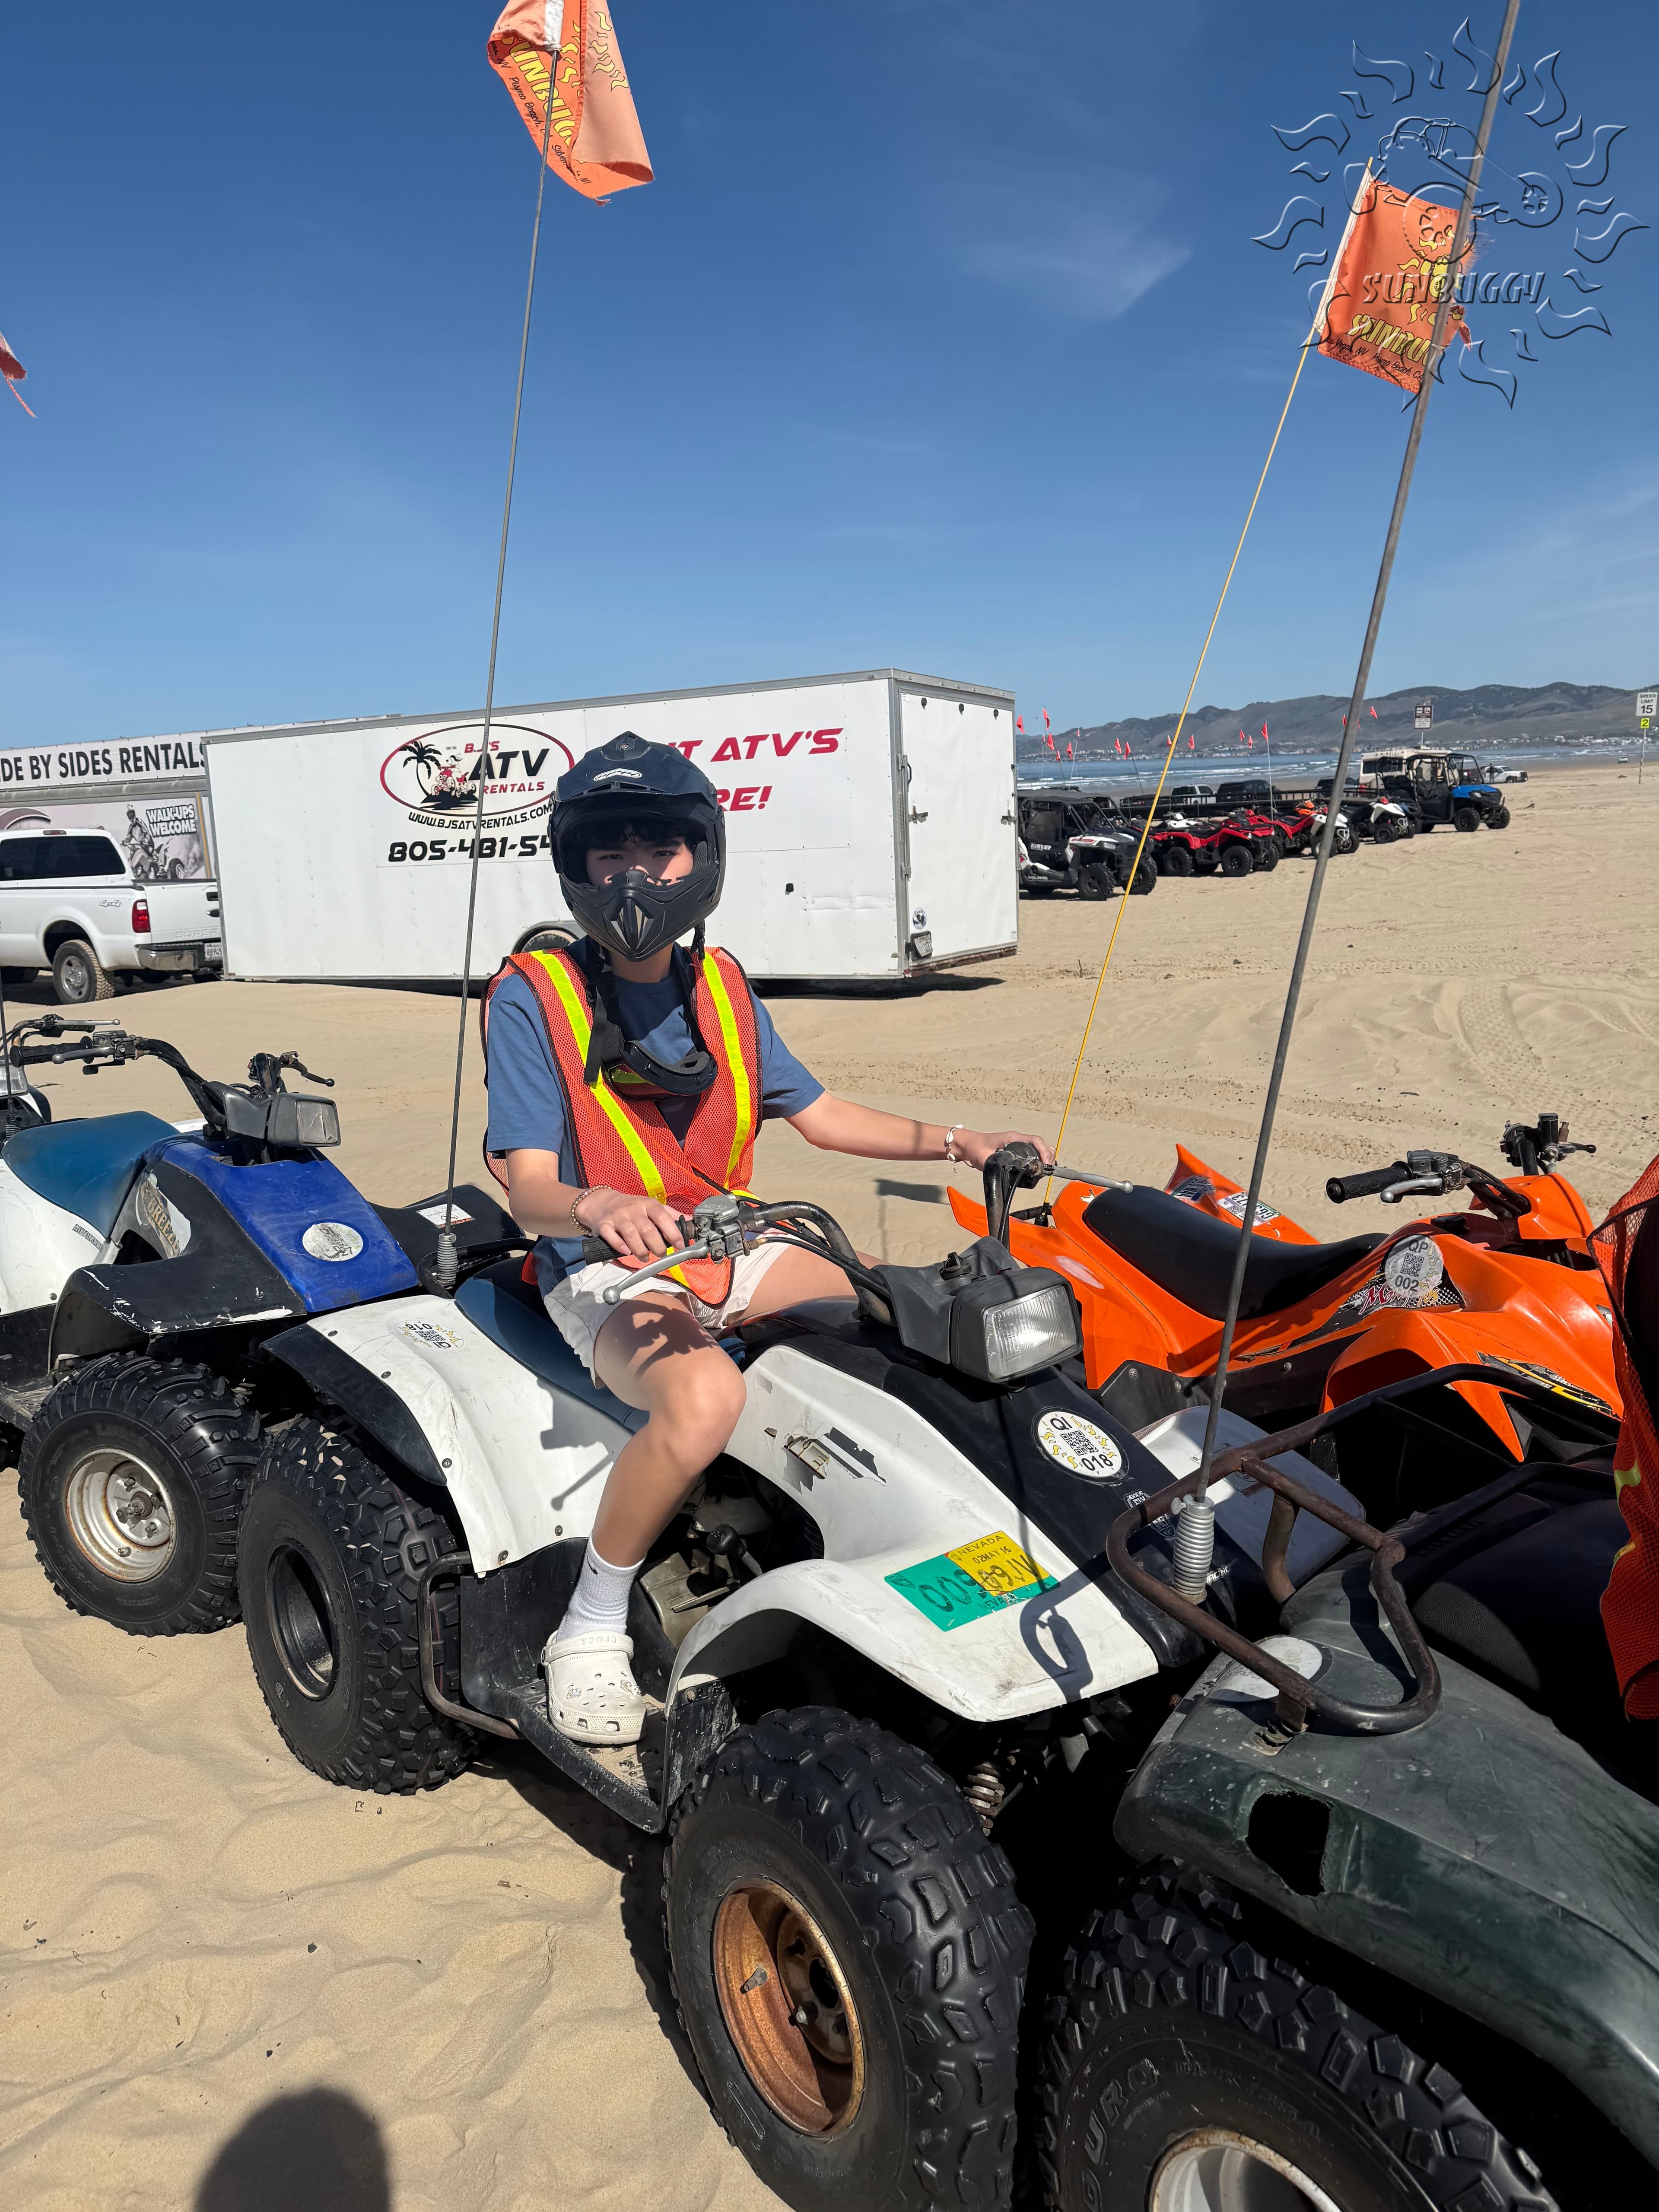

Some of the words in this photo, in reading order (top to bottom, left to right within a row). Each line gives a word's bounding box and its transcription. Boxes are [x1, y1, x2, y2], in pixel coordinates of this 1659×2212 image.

[509, 76, 527, 100] Pismo
[1640, 705, 1653, 713] 15
[710, 728, 844, 762] ATV'S
[29, 754, 52, 779] BY
[57, 749, 113, 778] SIDES
[468, 748, 550, 781] ATV
[483, 782, 546, 794] RENTALS
[146, 804, 195, 823] WALK-UPS
[148, 819, 197, 837] WELCOME
[1408, 1239, 1429, 1253] QP
[1394, 1274, 1419, 1292] 002
[1050, 1417, 1073, 1430] QI
[1081, 1454, 1113, 1471] 018
[957, 1535, 1004, 1556] NEVADA
